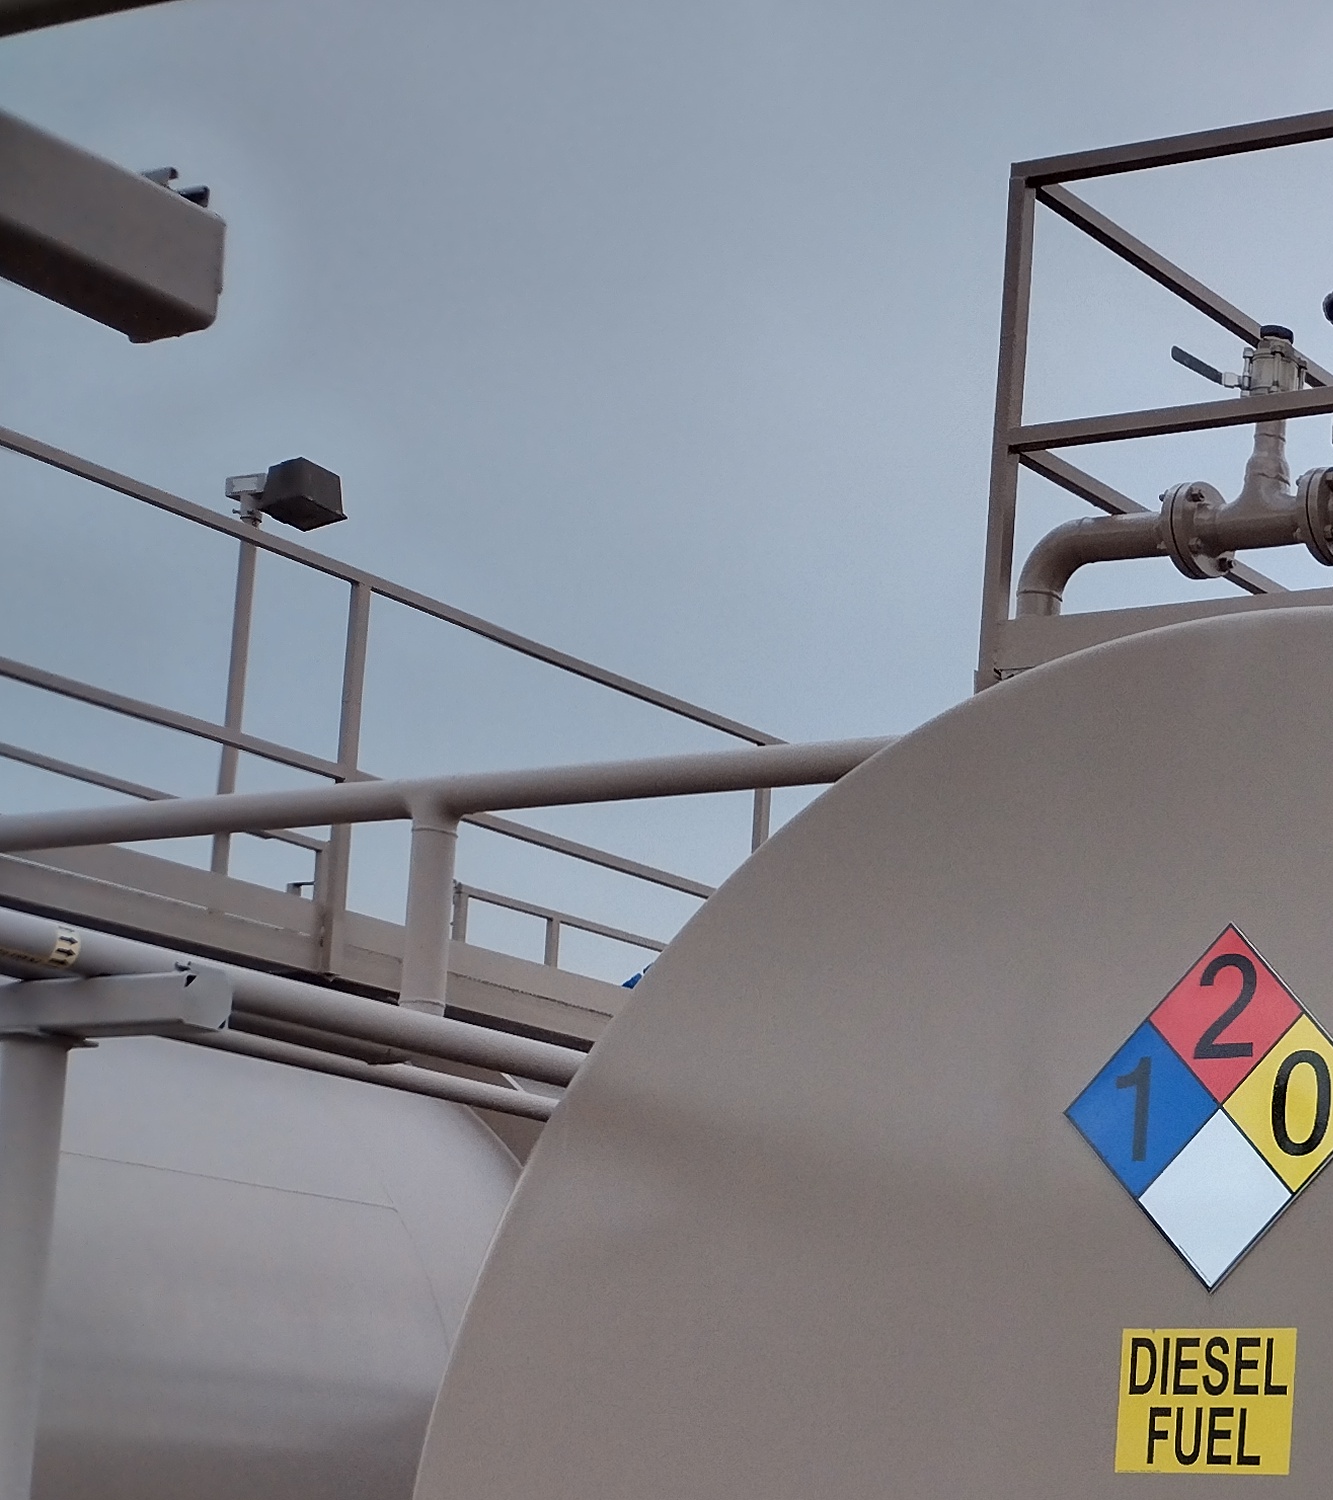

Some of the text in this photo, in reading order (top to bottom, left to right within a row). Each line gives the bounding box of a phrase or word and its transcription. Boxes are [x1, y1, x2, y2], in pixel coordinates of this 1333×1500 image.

[1193, 953, 1258, 1060] 2
[1115, 1056, 1153, 1162] 1
[1270, 1049, 1332, 1157] 0
[1128, 1336, 1288, 1396] DIESEL
[1146, 1406, 1261, 1466] FUEL
